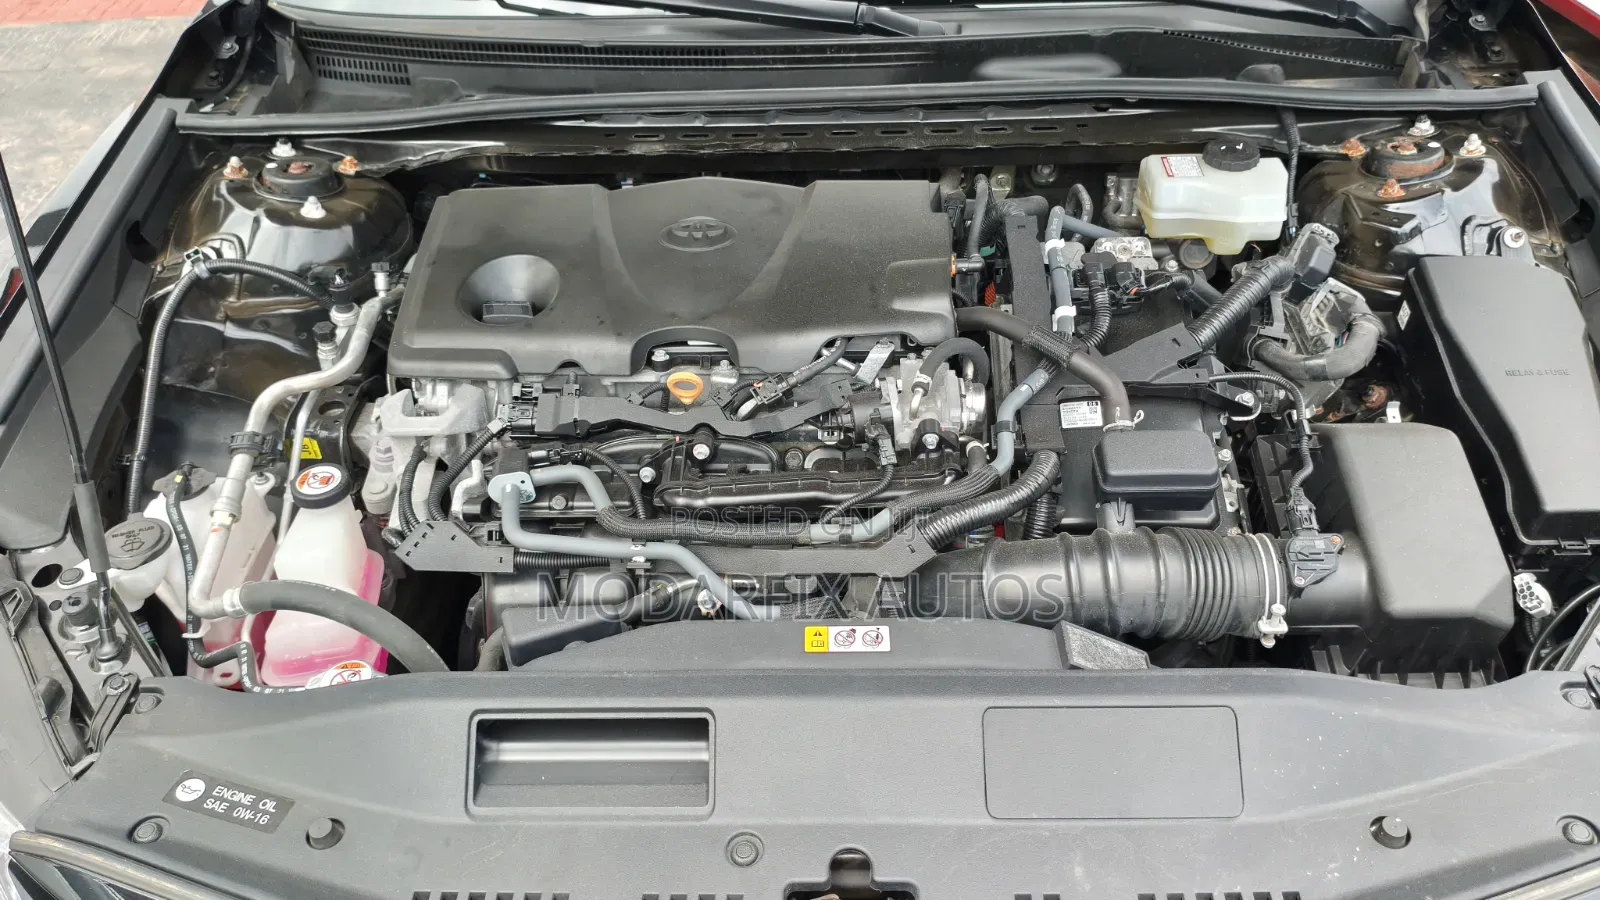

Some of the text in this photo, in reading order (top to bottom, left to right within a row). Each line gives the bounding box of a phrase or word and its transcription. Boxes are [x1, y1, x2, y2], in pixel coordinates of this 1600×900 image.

[1505, 368, 1534, 376] RELAY
[203, 798, 270, 825] SAE 0W-16
[212, 786, 277, 813] ENGINE OIL
